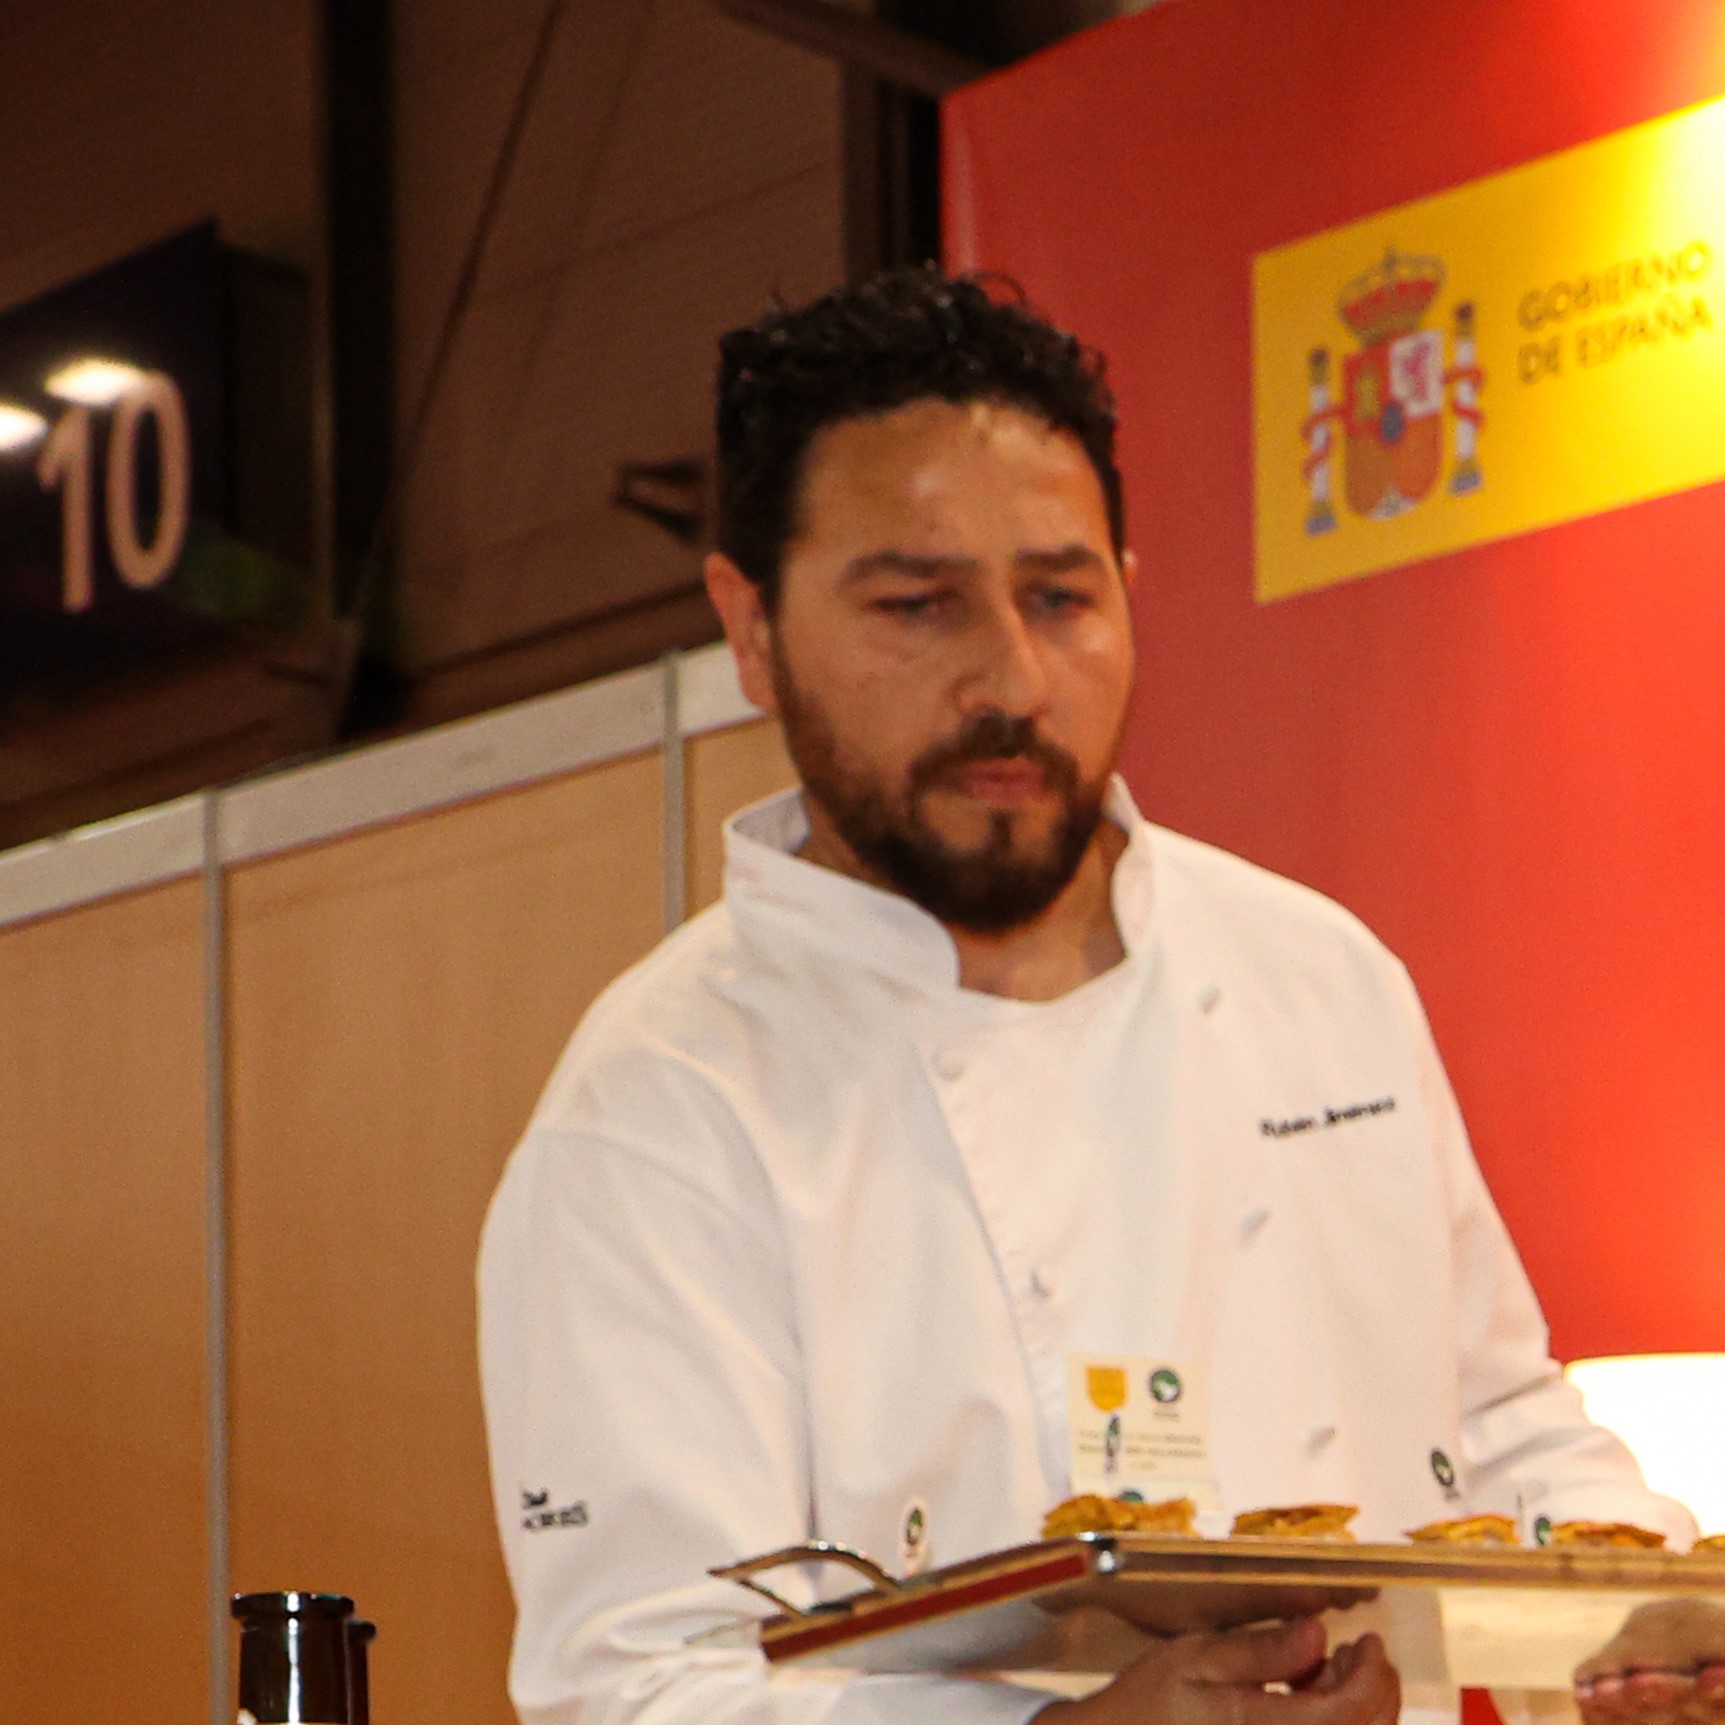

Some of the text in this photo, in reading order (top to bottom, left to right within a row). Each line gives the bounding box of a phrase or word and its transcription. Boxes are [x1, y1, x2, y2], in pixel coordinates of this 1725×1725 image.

[1517, 241, 1711, 333] GOBIERNO
[1517, 297, 1714, 386] DE ESPAÑA
[35, 369, 191, 613] 10
